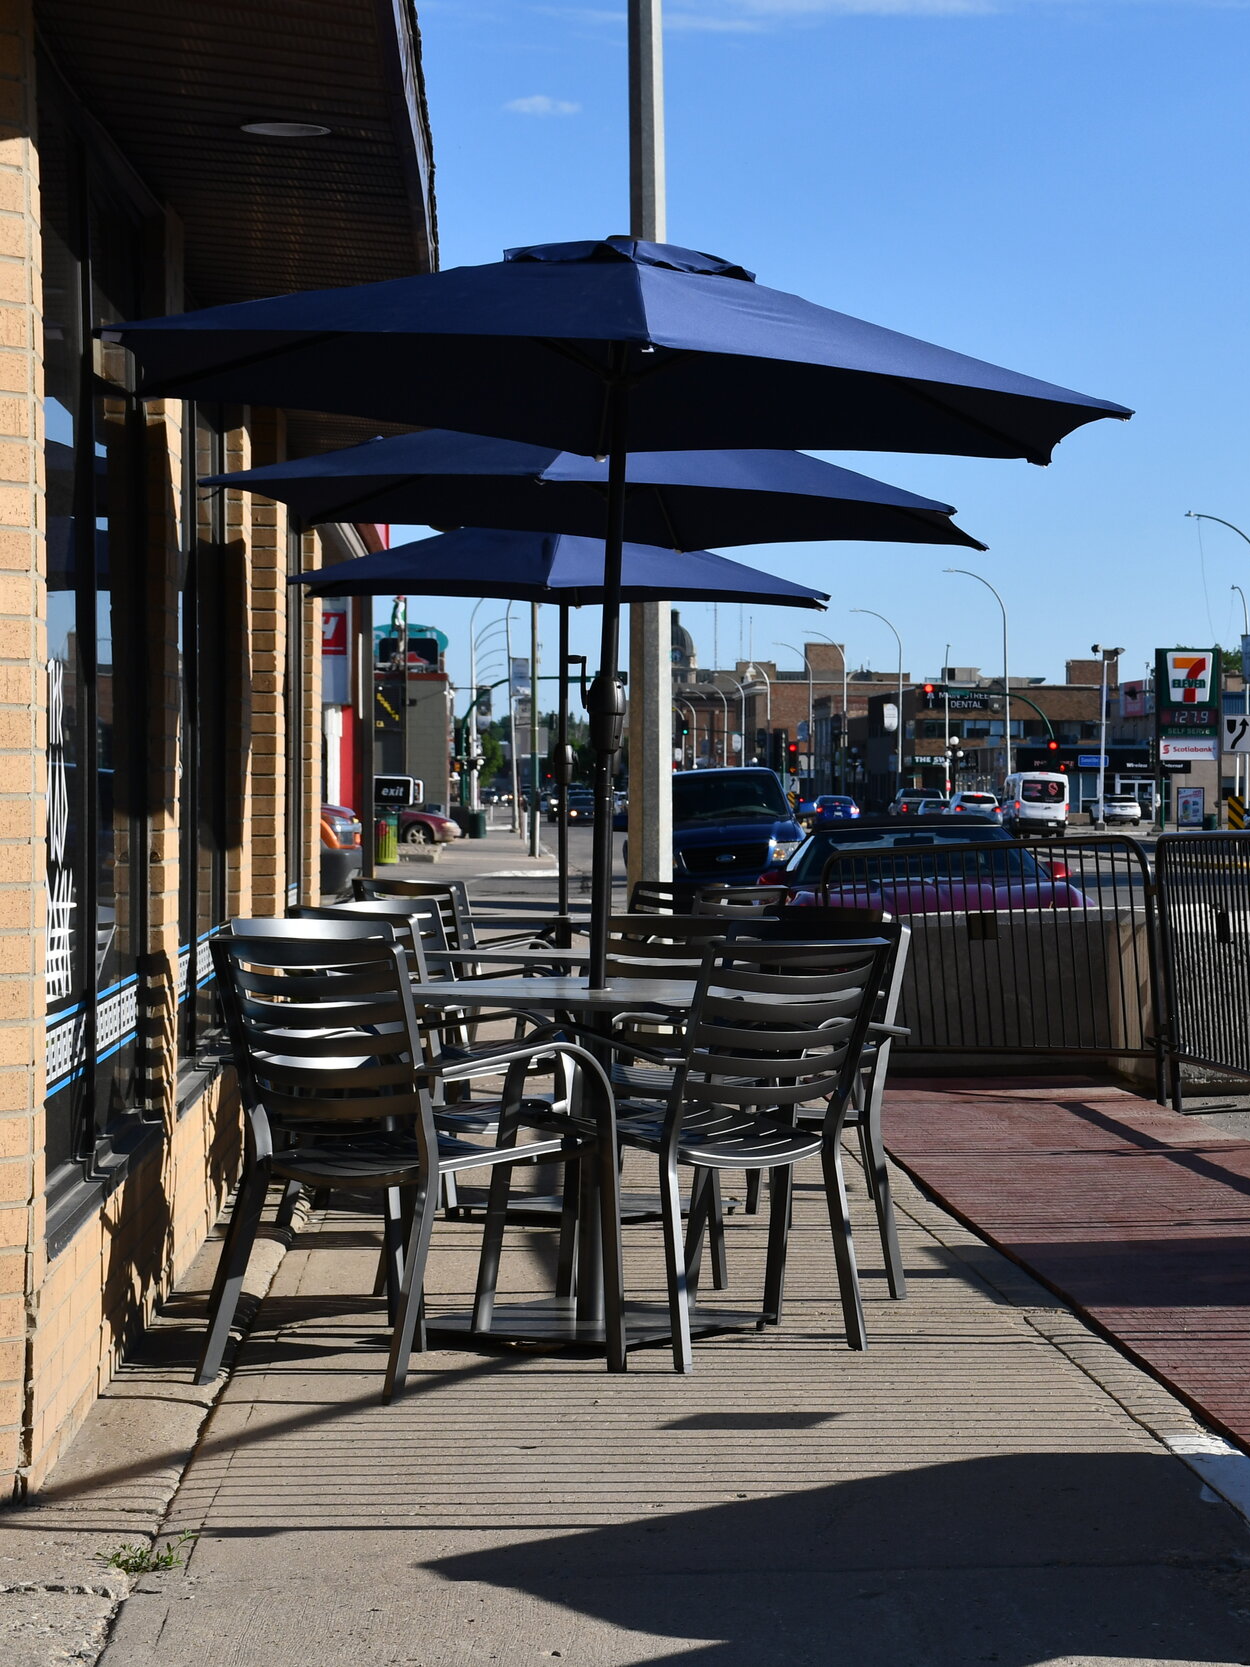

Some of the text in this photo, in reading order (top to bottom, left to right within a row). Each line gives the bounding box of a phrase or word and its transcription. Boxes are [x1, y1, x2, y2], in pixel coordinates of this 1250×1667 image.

[1171, 678, 1206, 689] ELEVEN
[1172, 657, 1207, 703] 7
[965, 691, 990, 699] STREE
[950, 700, 984, 709] DENTAL
[1174, 711, 1209, 724] 127.9
[1167, 727, 1211, 735] SELF SERVE
[1172, 745, 1213, 753] Scotiabank
[381, 785, 404, 797] exit
